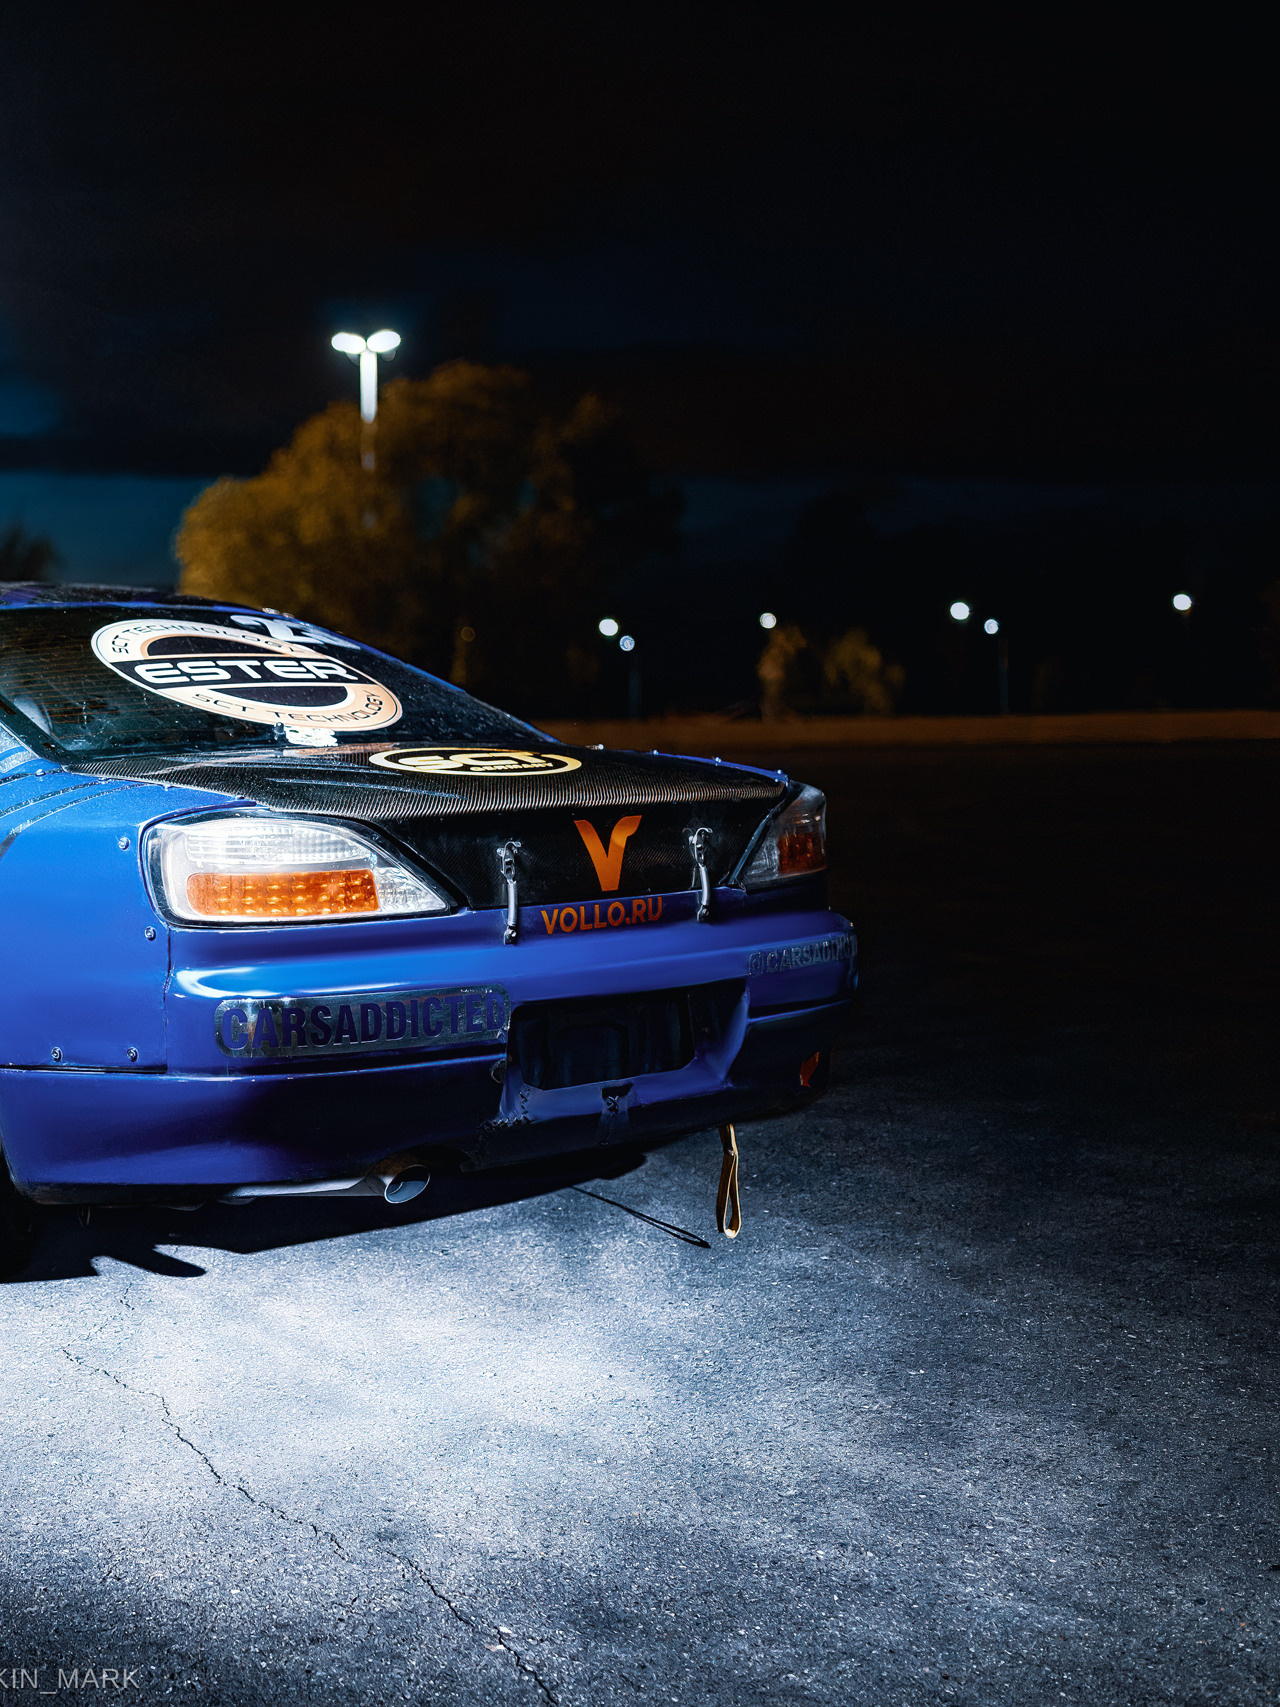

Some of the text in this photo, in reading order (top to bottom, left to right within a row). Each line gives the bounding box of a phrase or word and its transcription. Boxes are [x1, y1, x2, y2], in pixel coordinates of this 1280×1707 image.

[111, 624, 307, 655] SCT TECHNOLOGY
[134, 660, 359, 684] ESTER
[192, 690, 384, 724] SCT TECHNOLOGY
[397, 752, 547, 772] SCT
[541, 896, 663, 935] VOLLO.RU
[221, 992, 506, 1050] CARSADDICTED
